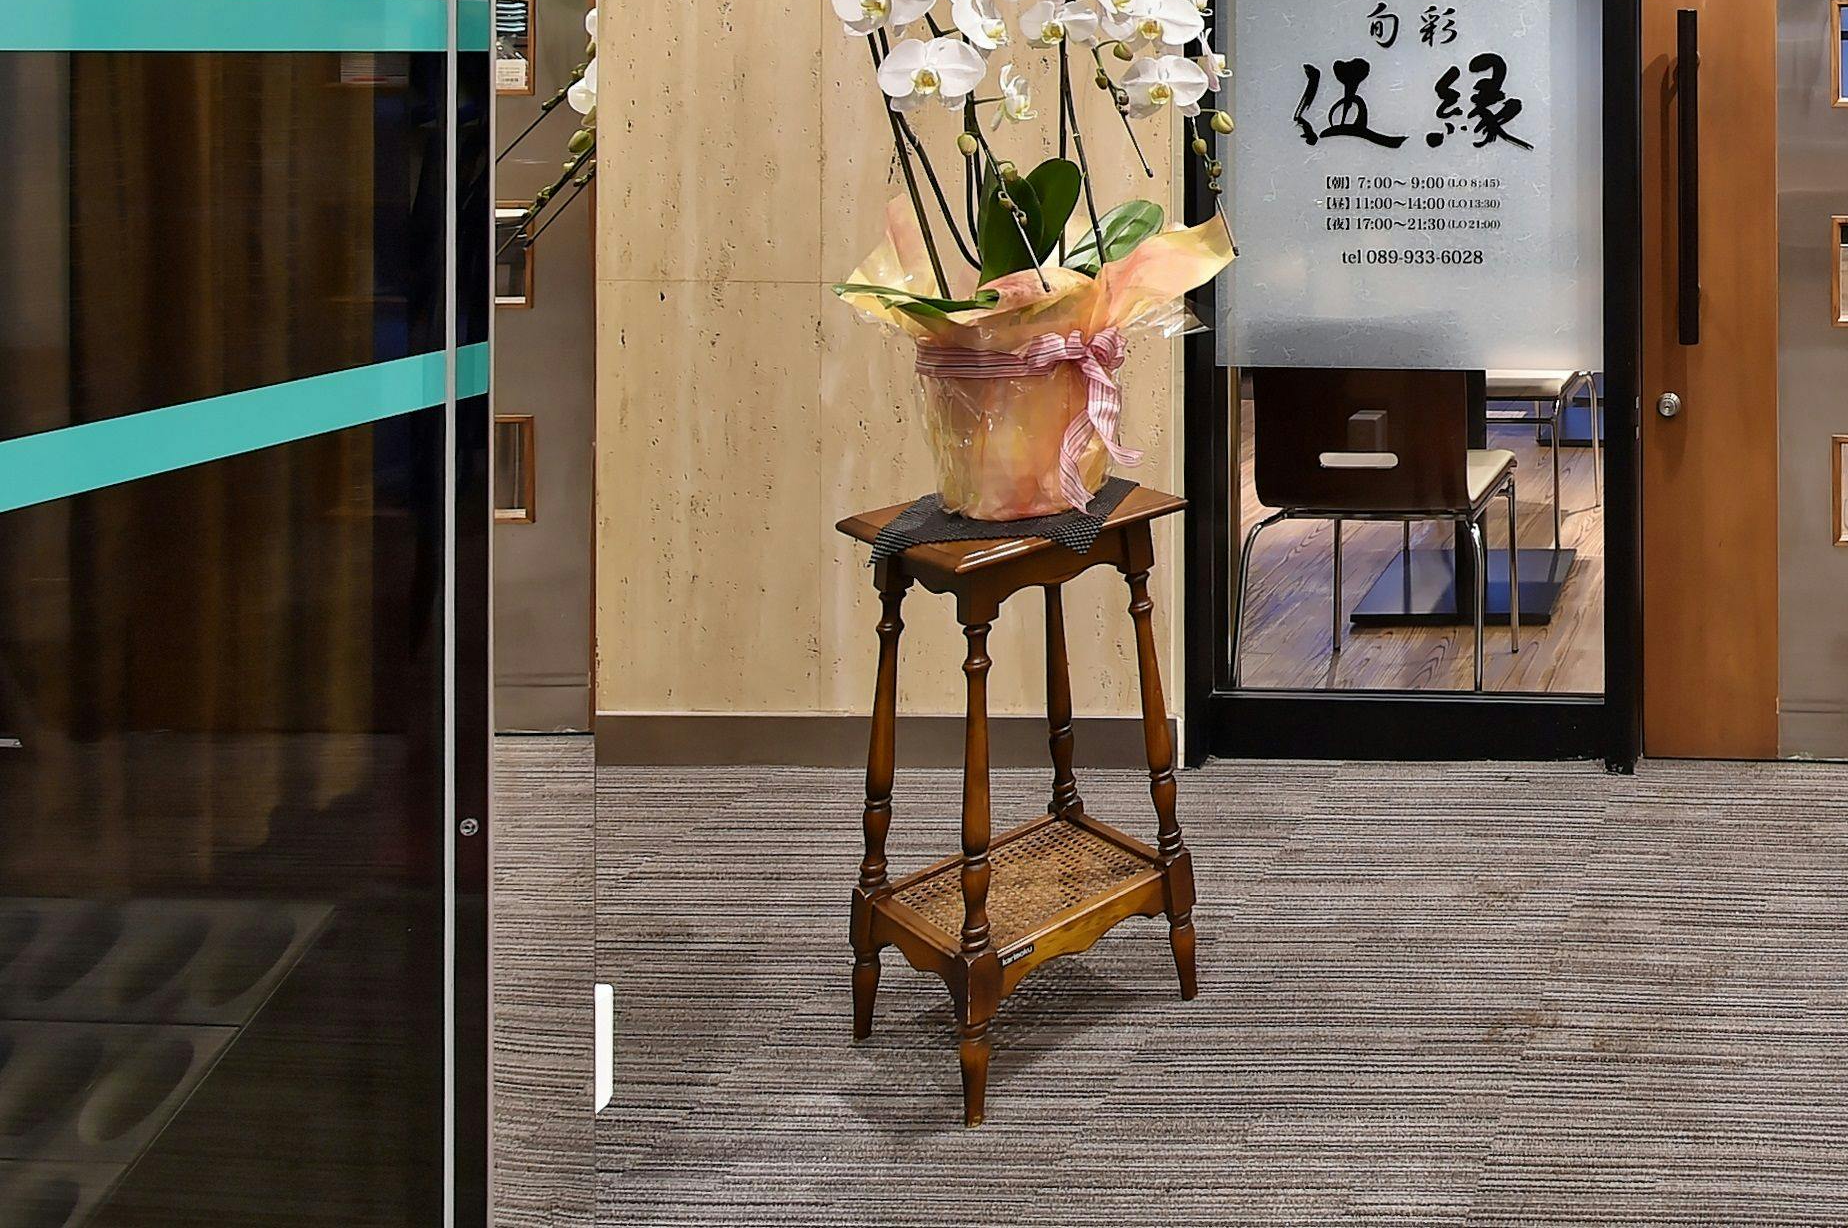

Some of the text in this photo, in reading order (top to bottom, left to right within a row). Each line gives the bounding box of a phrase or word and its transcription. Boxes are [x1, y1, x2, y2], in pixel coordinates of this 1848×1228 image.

[1366, 2, 1458, 48] 旬彩
[1293, 53, 1535, 151] 伍縁
[1342, 249, 1483, 264] tel 089-933-6028
